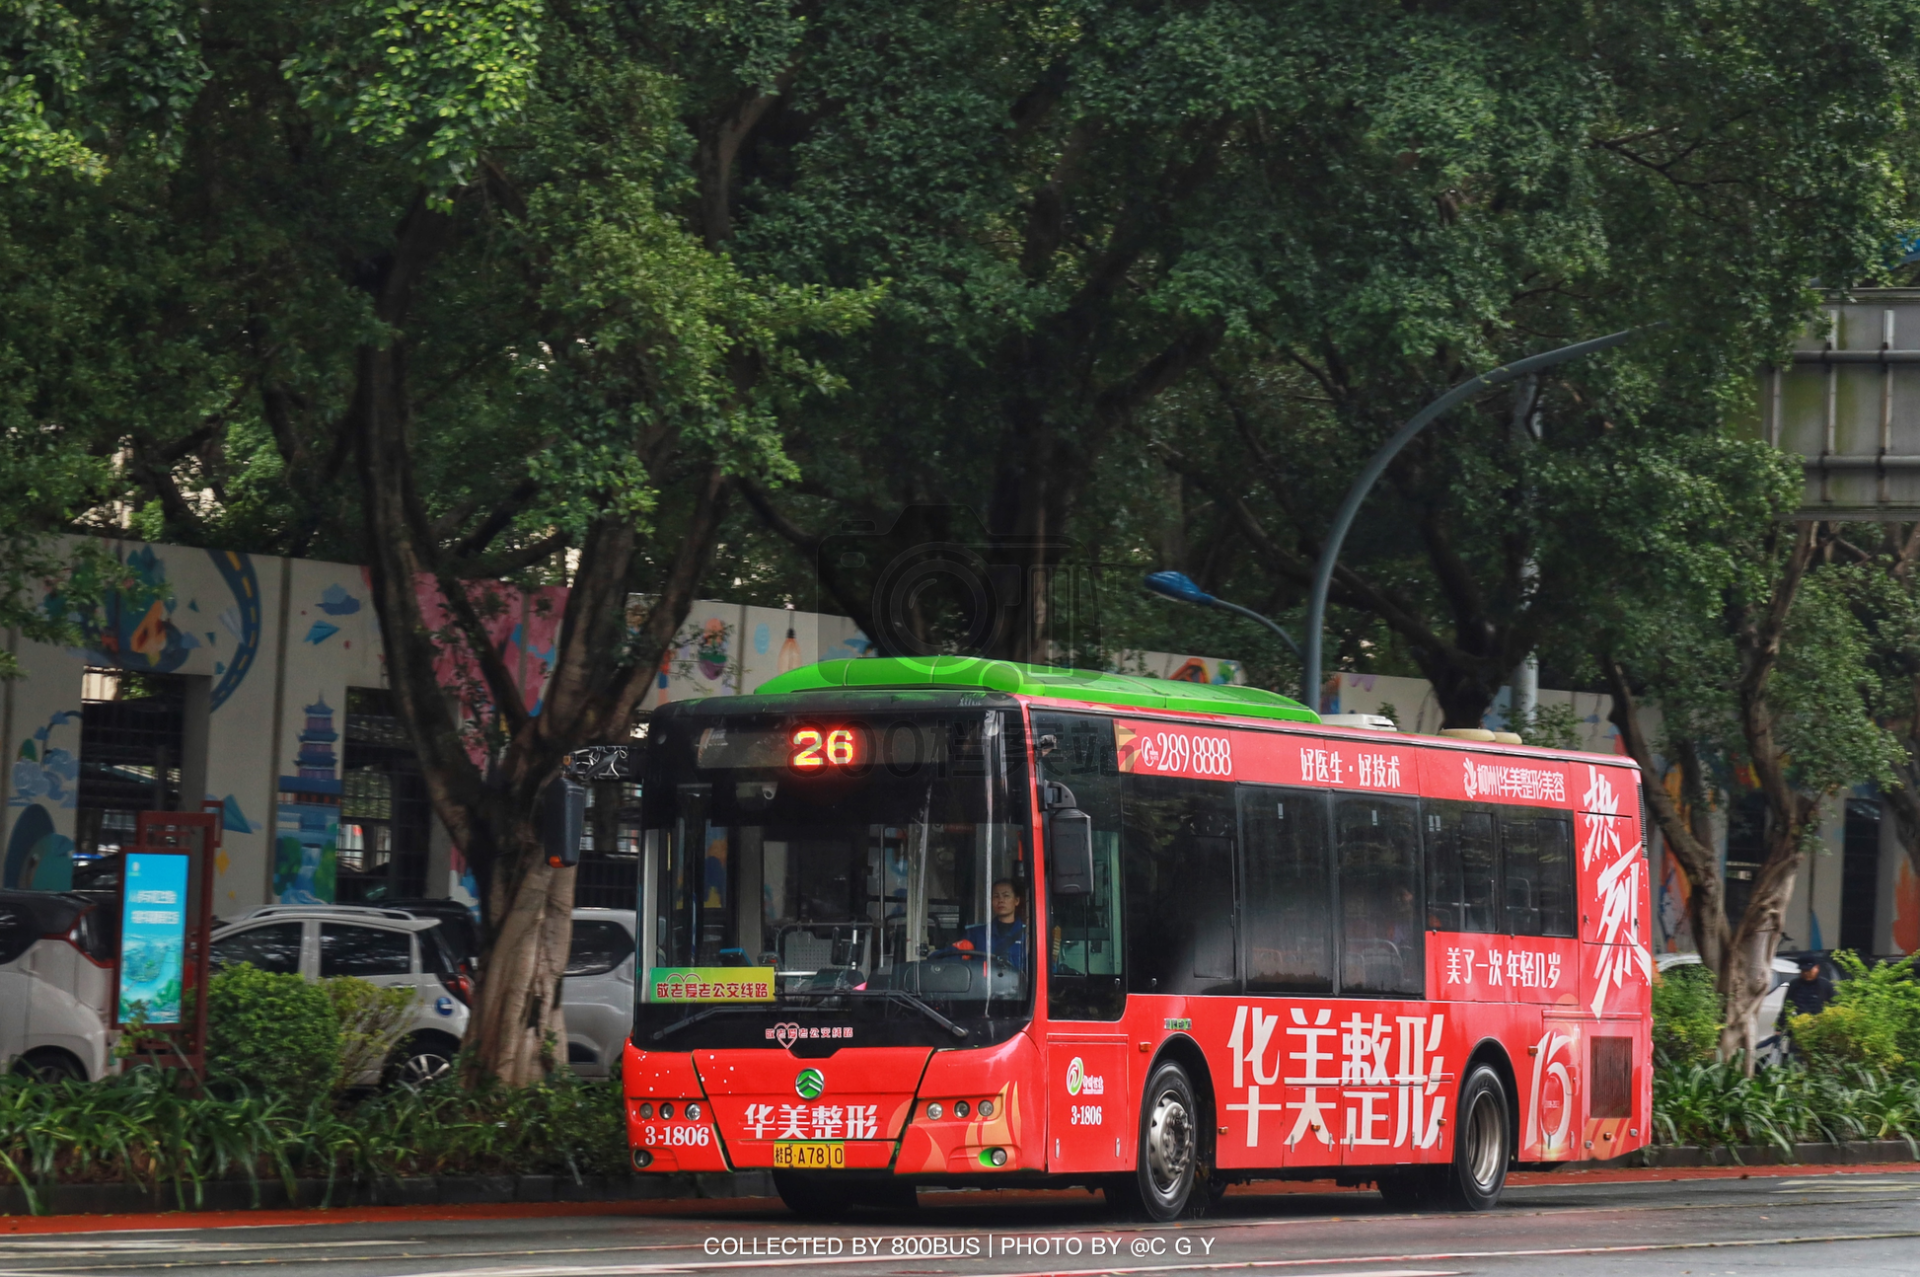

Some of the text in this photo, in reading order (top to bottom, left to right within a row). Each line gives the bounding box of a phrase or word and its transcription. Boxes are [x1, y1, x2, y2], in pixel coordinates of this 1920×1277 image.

[793, 730, 854, 766] 26
[1447, 947, 1561, 989] 美了一次 年轻几岁
[656, 982, 769, 998] 敬老爱老公交线路
[1226, 1004, 1446, 1150] 华美整形
[743, 1104, 878, 1139] 华美整形
[1071, 1105, 1102, 1125] 3-1806
[645, 1125, 709, 1146] 3-1806
